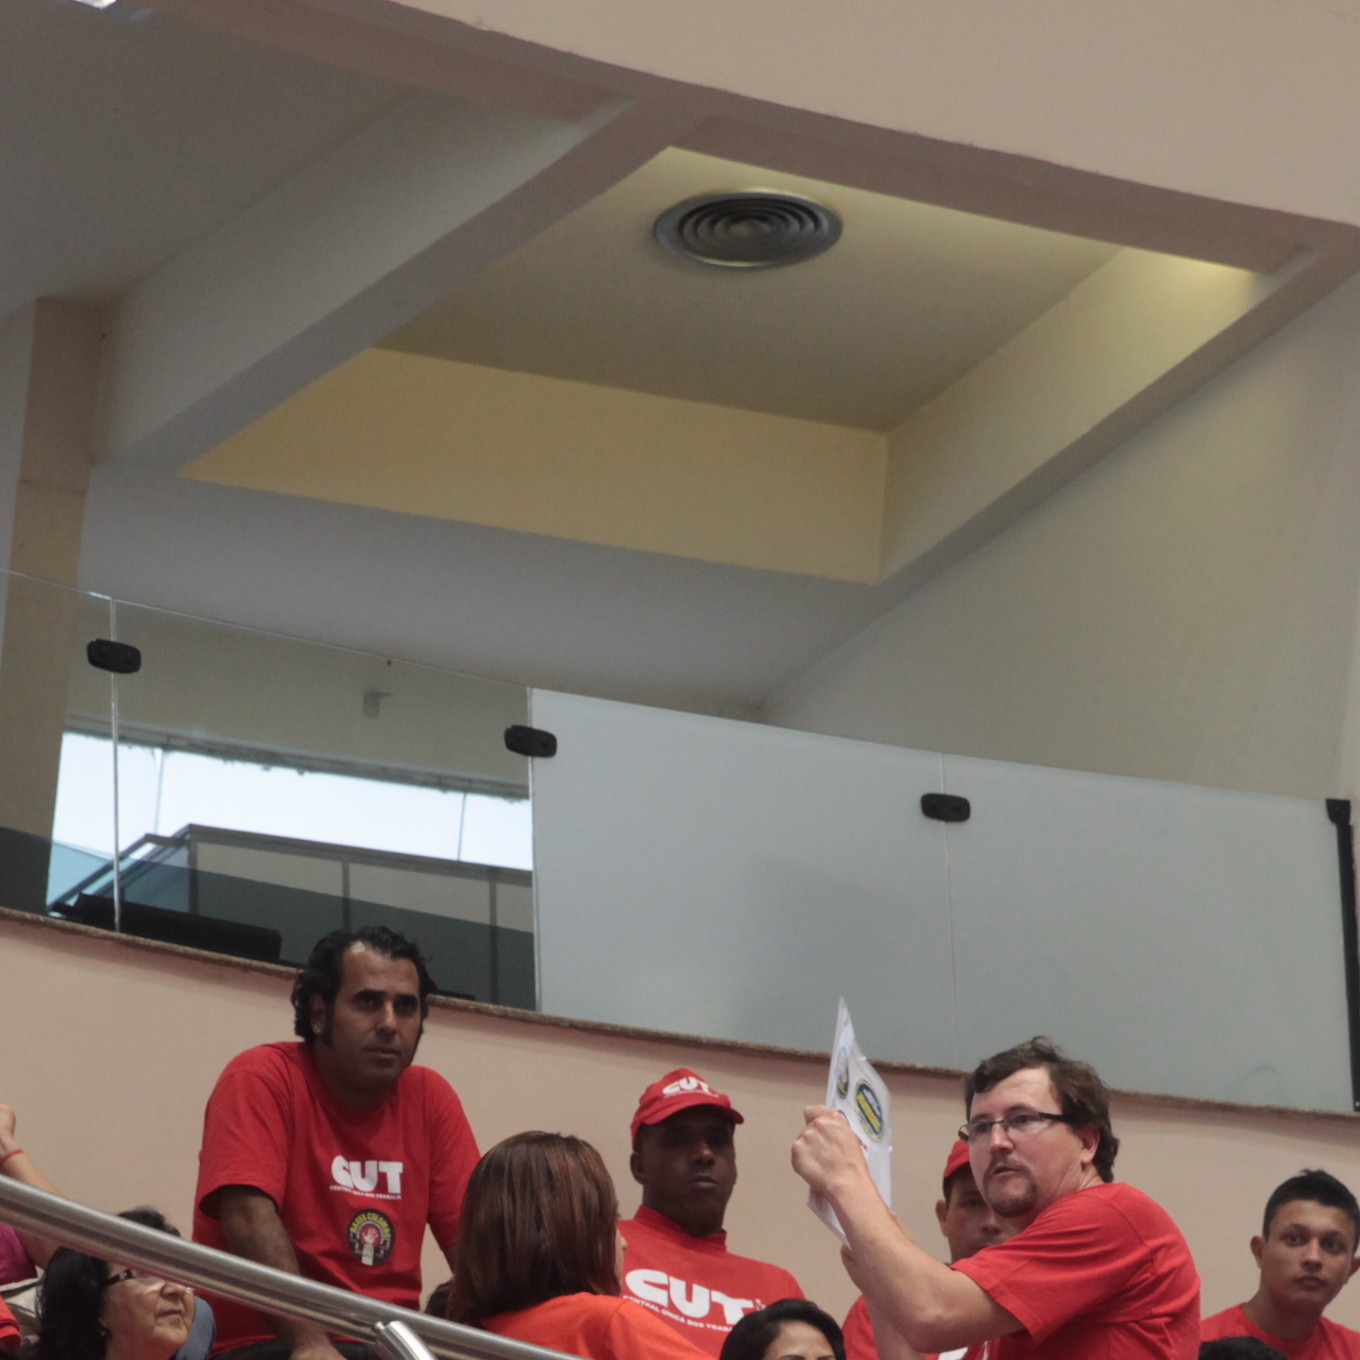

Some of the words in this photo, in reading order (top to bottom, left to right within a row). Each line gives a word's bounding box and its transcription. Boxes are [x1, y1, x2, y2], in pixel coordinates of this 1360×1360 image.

[663, 1077, 710, 1094] CUT
[331, 1155, 403, 1194] CUT
[625, 1269, 754, 1325] CUT
